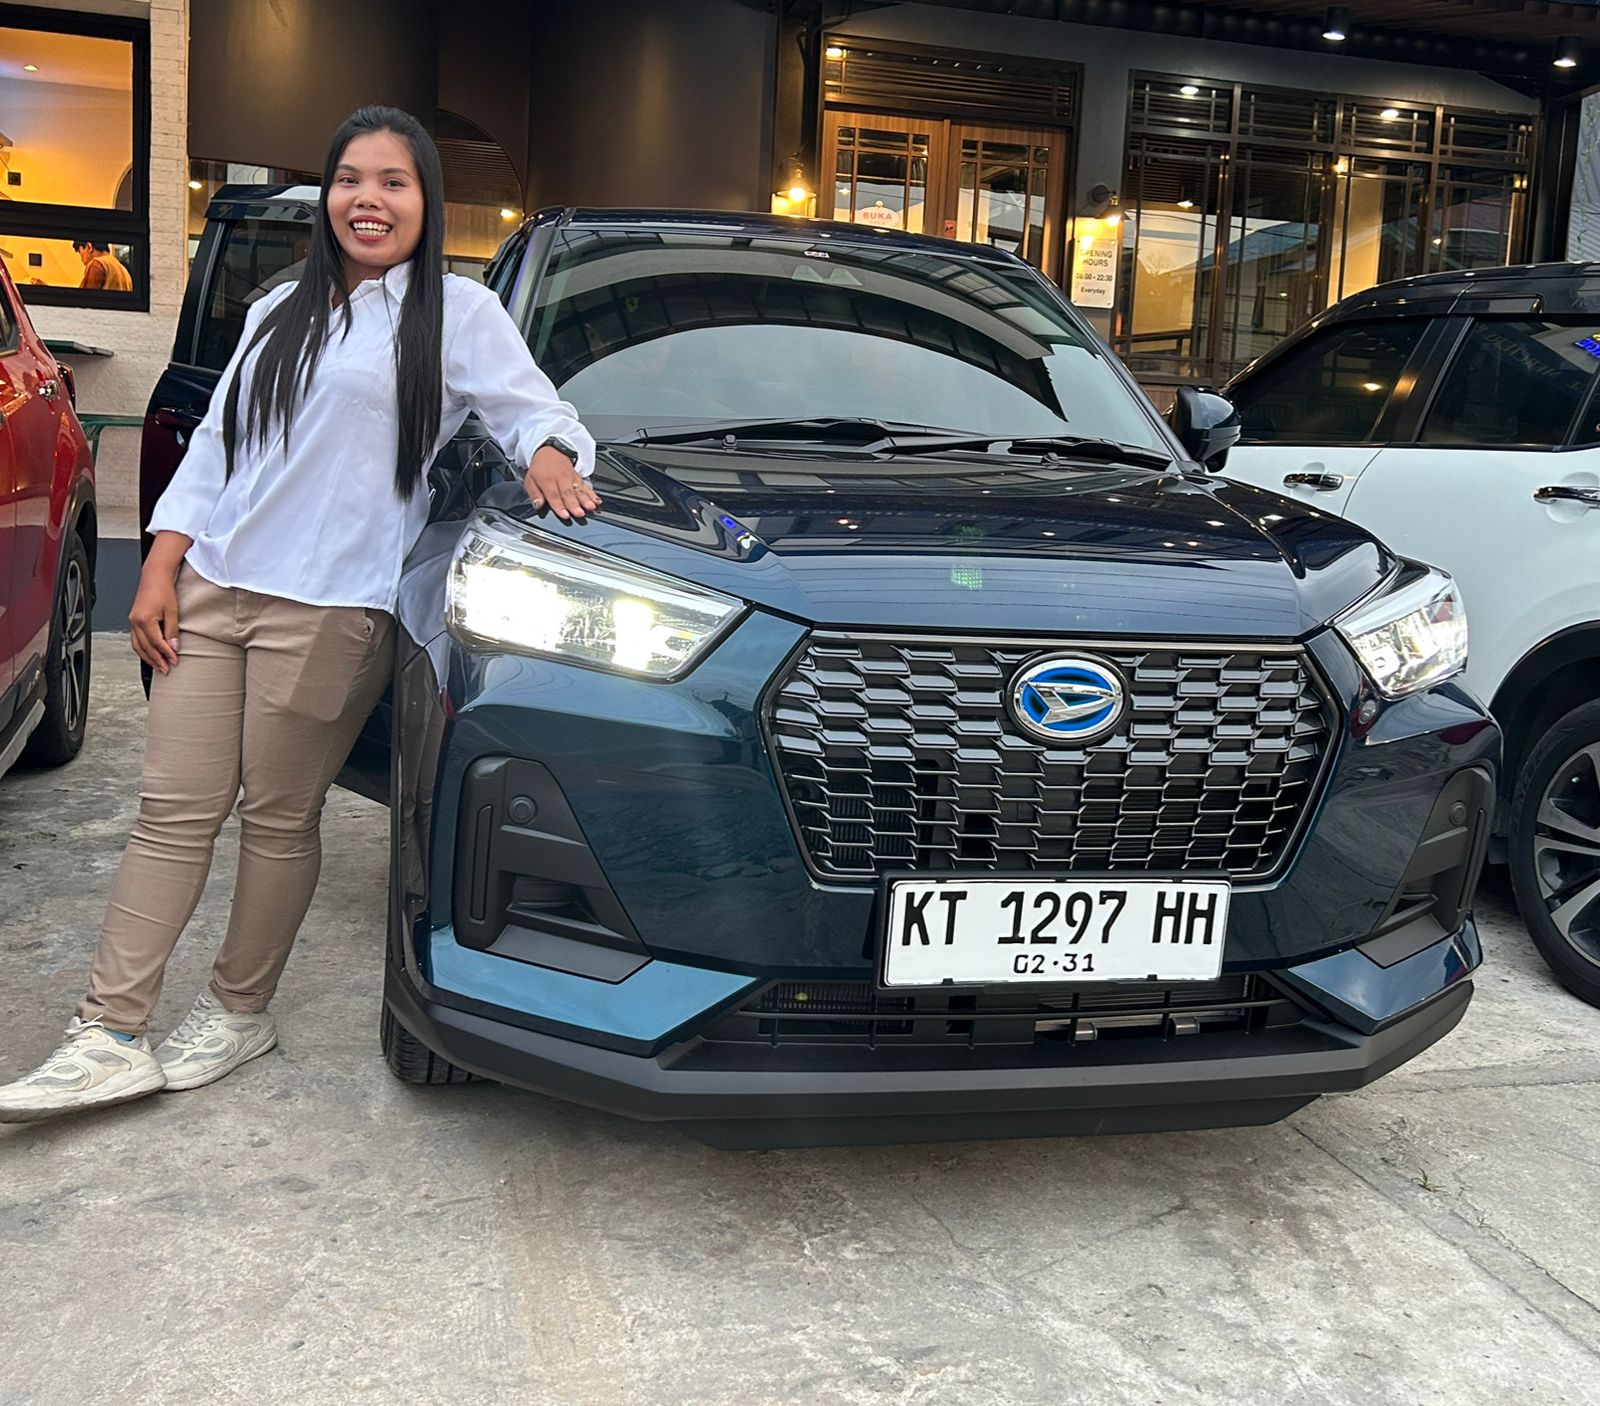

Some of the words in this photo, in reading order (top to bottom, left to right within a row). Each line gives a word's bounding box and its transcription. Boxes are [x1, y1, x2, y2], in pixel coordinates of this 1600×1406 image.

[863, 212, 892, 220] BUKA
[1080, 249, 1112, 259] OPENING
[1083, 259, 1109, 267] HOURS
[1081, 286, 1105, 295] Everyday
[901, 890, 967, 946] KT
[998, 890, 1127, 945] 1297
[1152, 890, 1217, 945] HH
